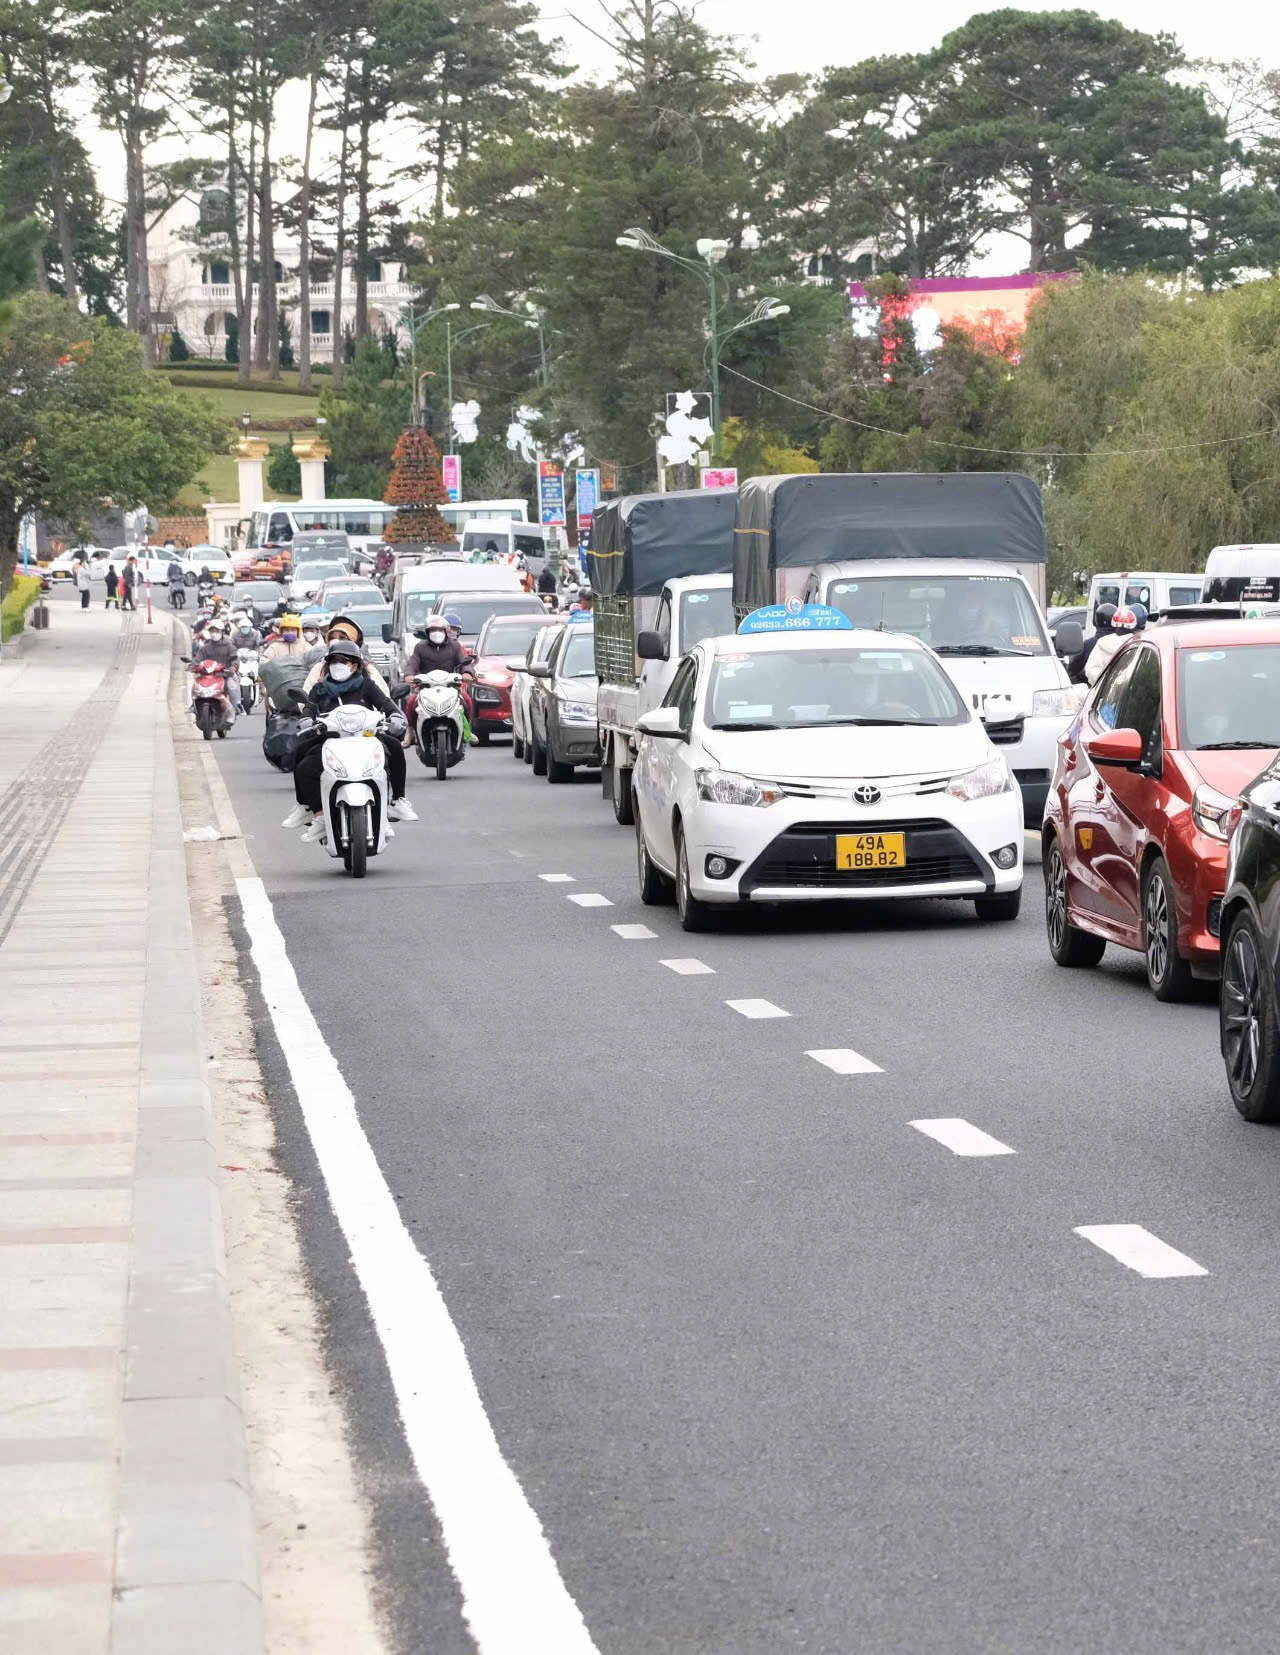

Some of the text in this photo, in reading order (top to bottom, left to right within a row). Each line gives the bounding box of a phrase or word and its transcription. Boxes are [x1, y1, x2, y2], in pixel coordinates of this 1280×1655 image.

[815, 616, 841, 627] 777
[856, 835, 885, 850] 49A
[845, 851, 898, 867] 188.82
